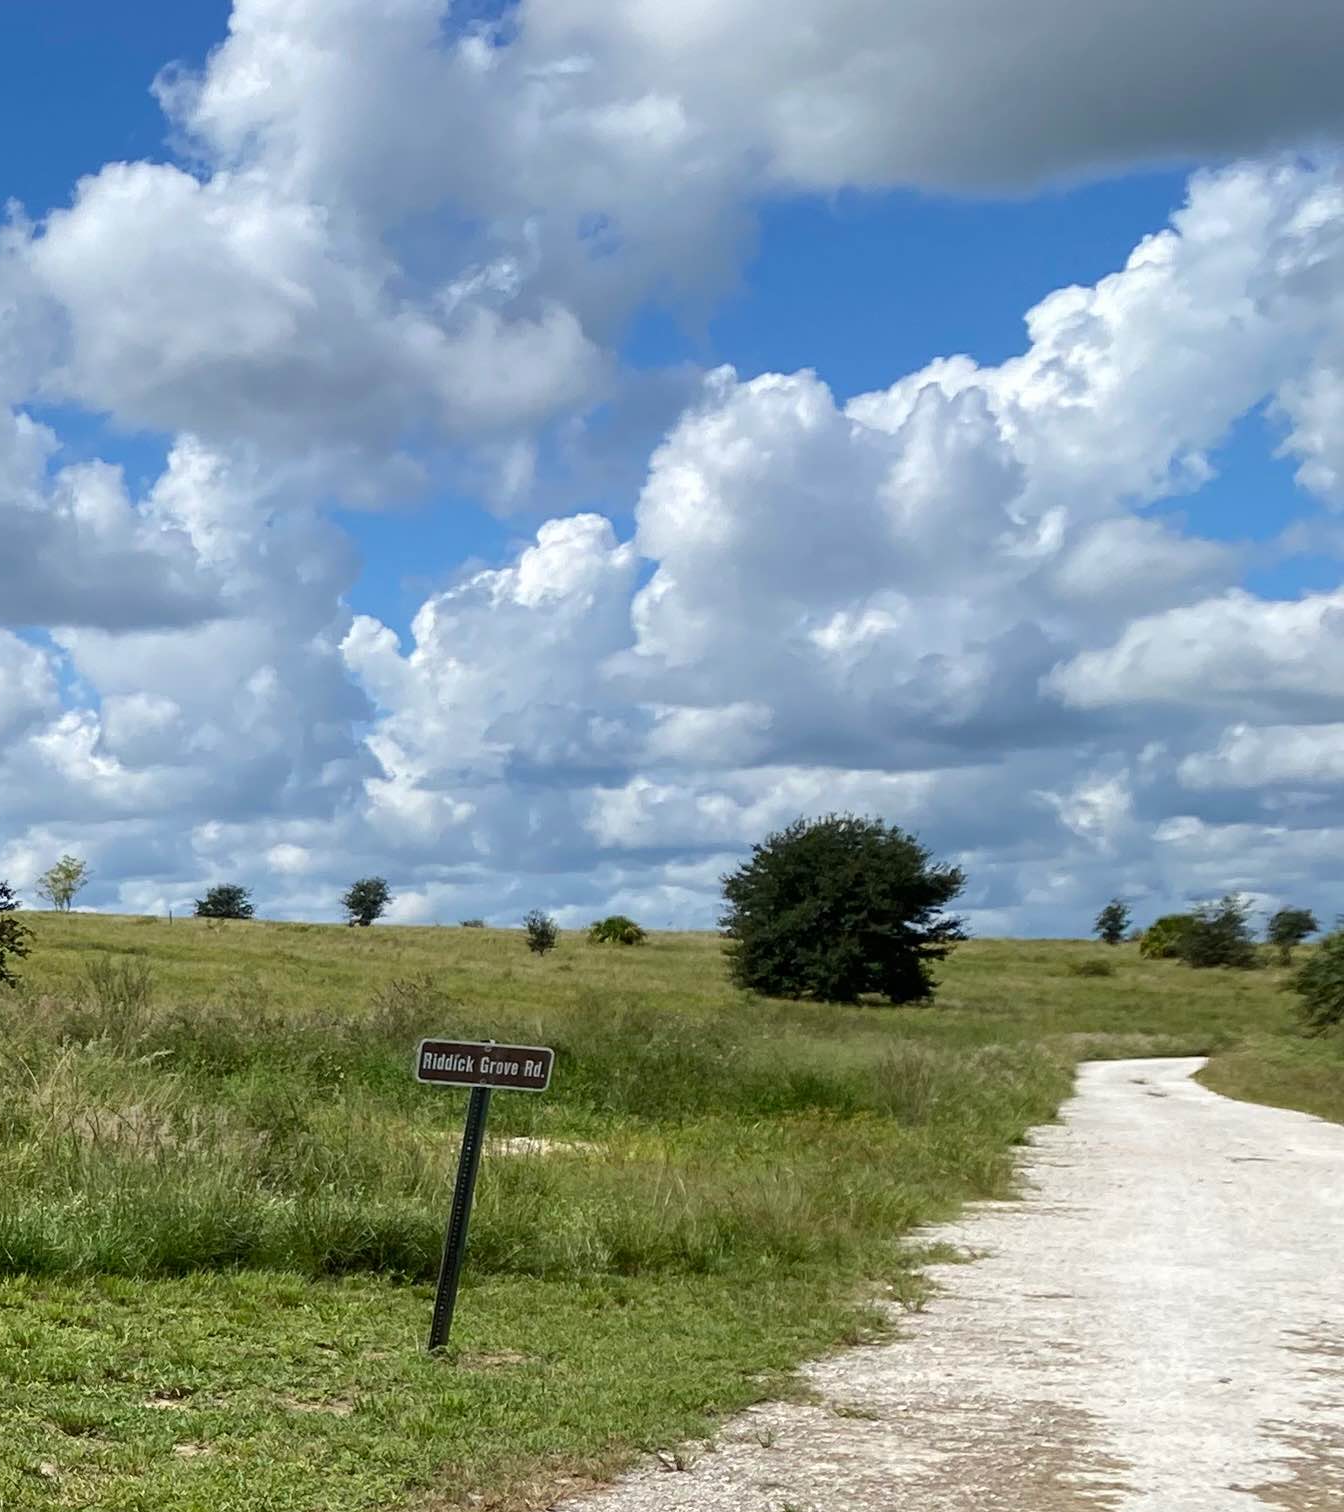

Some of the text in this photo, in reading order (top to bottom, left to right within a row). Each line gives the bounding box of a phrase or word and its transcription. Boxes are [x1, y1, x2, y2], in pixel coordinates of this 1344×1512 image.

[422, 1052, 545, 1078] Riddick Grove Rd.
